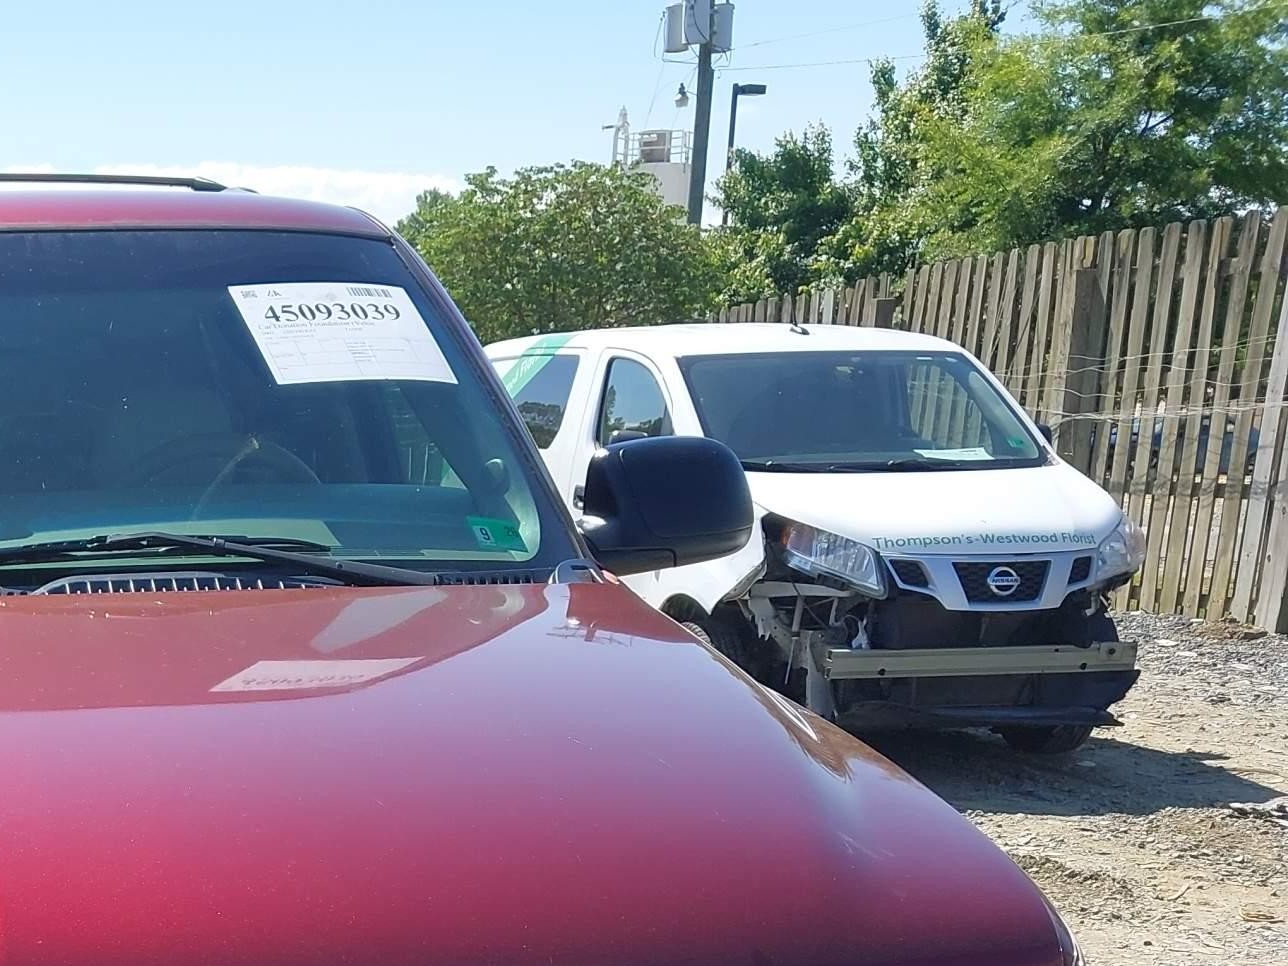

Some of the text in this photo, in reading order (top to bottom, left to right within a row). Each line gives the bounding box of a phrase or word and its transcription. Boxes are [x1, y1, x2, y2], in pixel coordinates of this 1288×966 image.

[264, 302, 401, 322] 45093039
[479, 527, 491, 541] 9
[872, 532, 1097, 549] Thompson's-Westwood Florist
